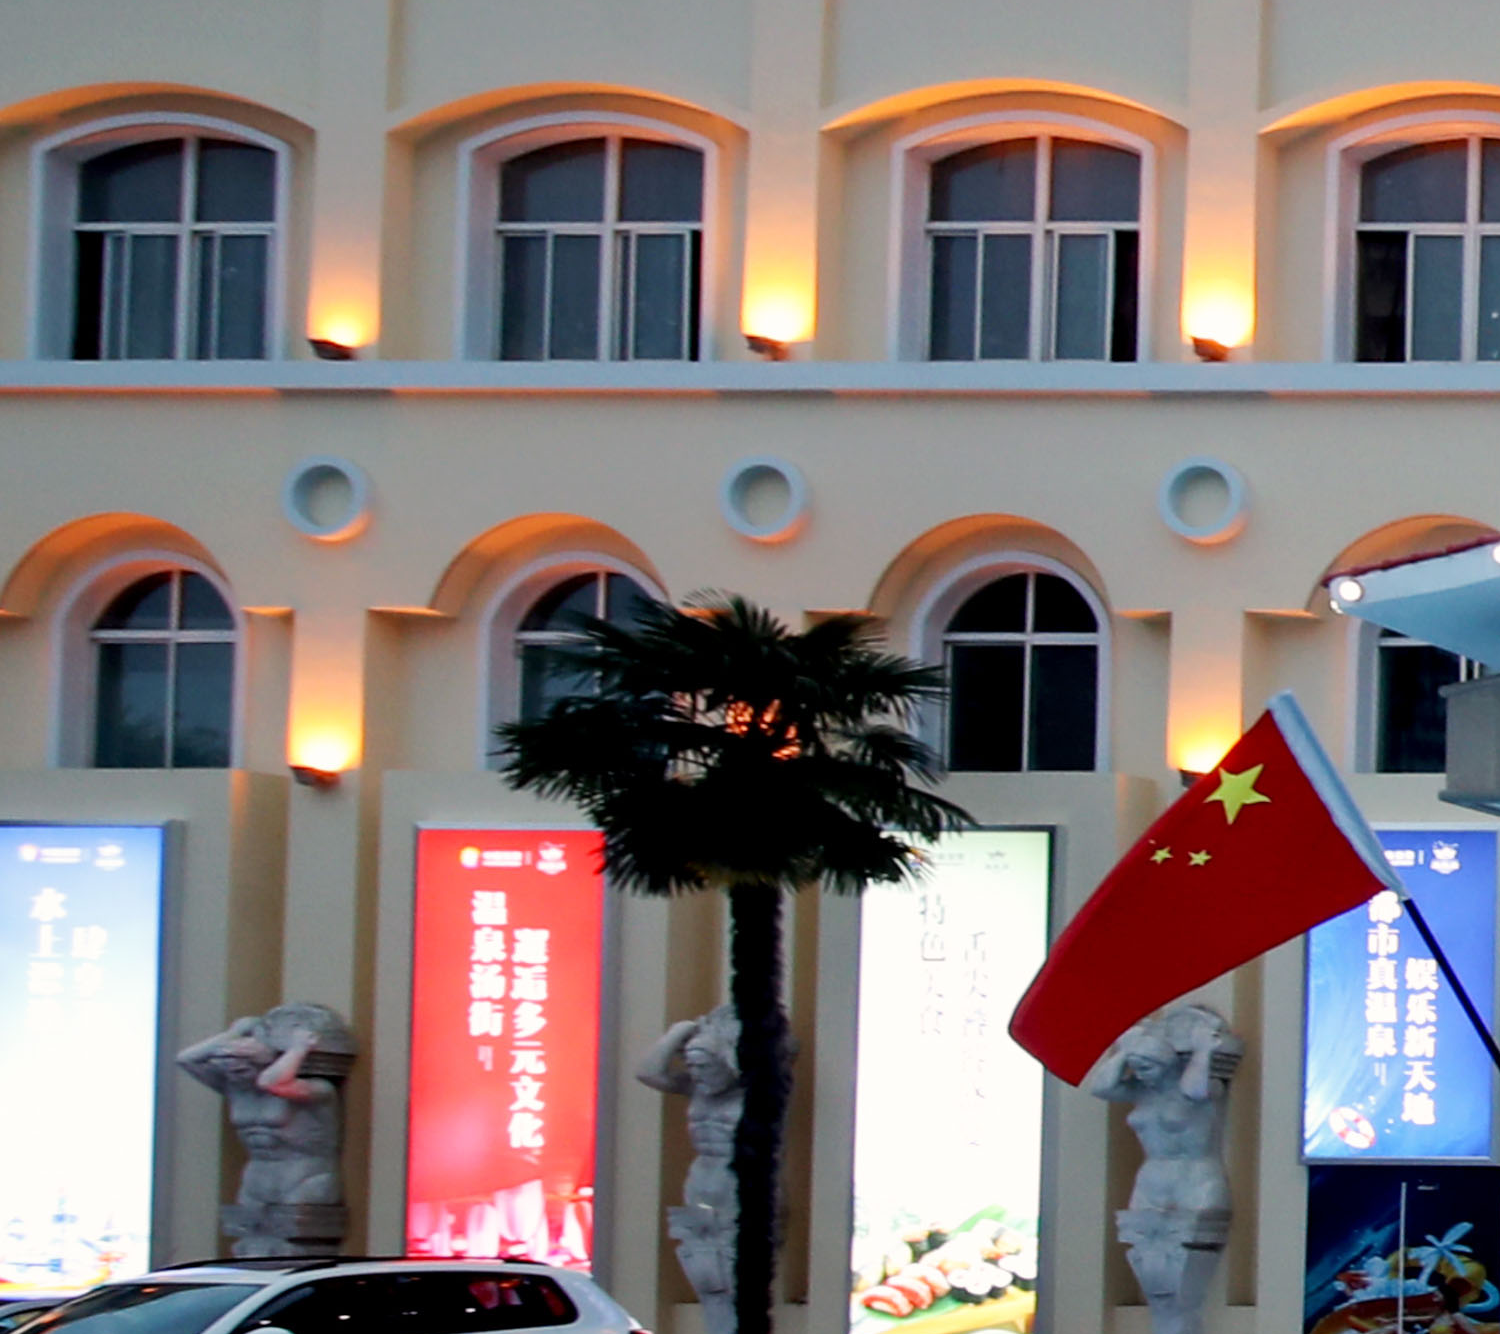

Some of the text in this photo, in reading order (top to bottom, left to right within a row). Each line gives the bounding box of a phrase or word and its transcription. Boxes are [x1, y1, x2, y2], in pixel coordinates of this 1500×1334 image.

[468, 891, 507, 1037] 温泉汤街
[1401, 957, 1439, 1126] 娱乐新天地
